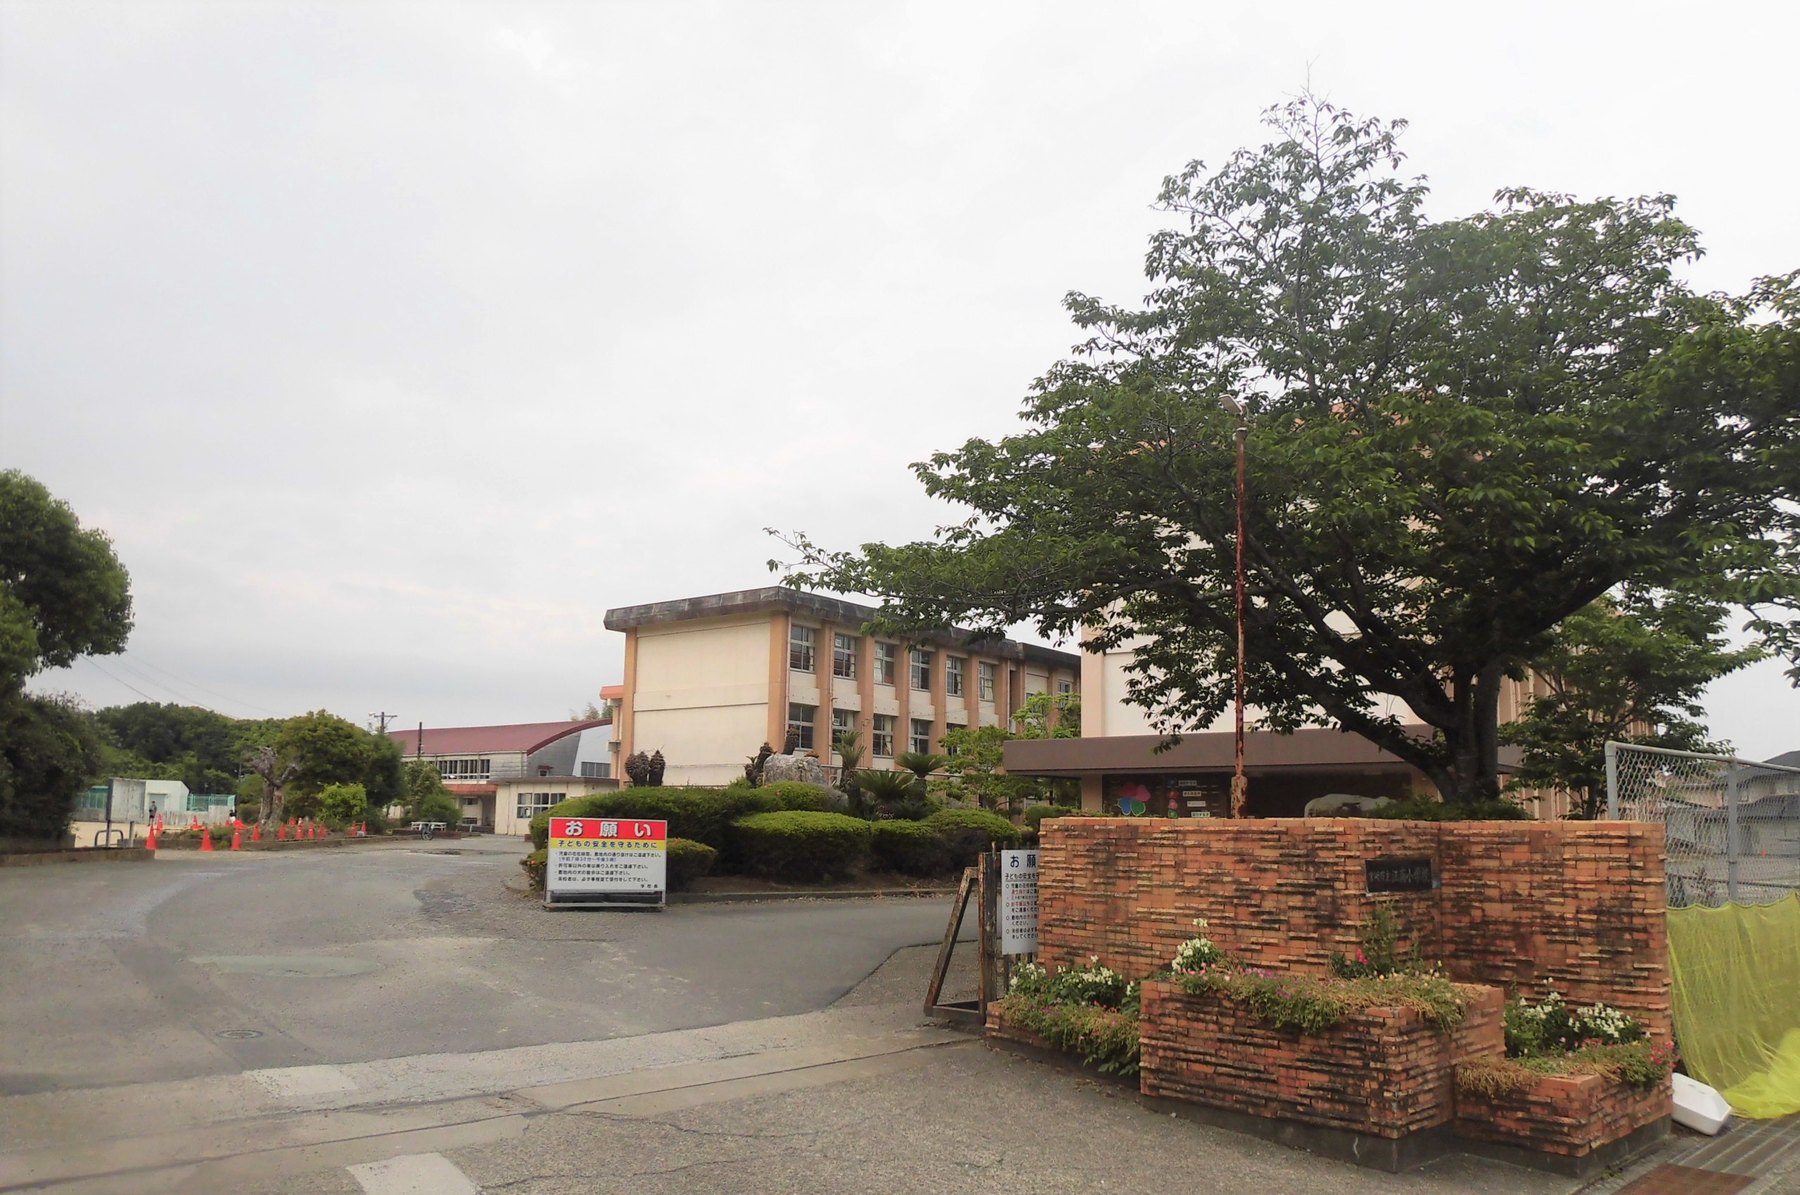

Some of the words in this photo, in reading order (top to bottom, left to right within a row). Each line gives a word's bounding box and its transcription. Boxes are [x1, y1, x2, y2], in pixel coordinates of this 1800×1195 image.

[565, 821, 652, 837] お願い
[558, 840, 657, 849] 子どもの安全を守るために
